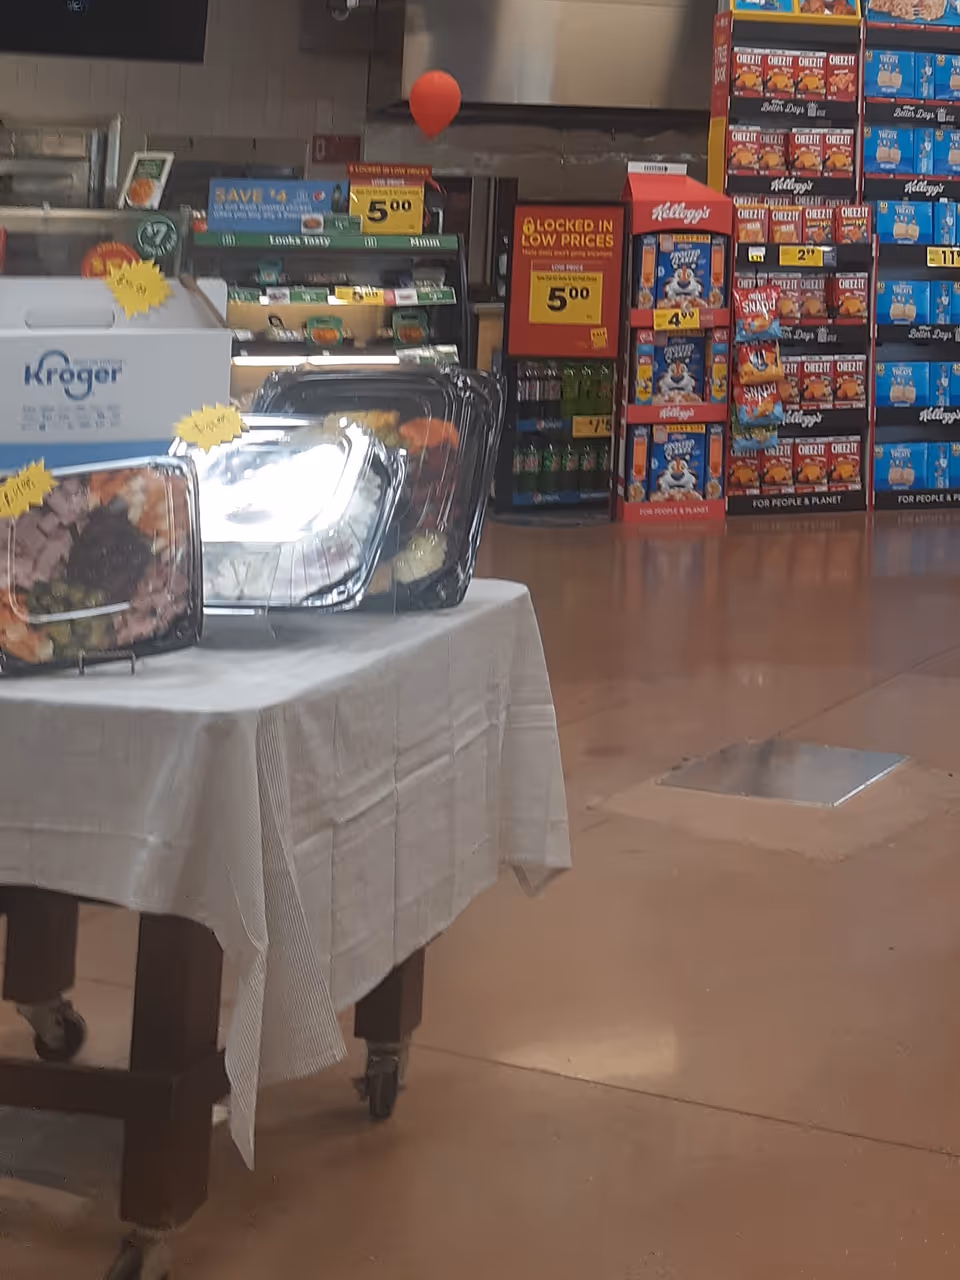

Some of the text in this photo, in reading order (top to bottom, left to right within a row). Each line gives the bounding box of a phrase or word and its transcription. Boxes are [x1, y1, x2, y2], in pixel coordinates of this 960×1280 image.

[770, 177, 813, 194] Kellogg's
[904, 180, 944, 196] Kellogg's
[215, 186, 263, 204] SAVE
[652, 201, 710, 224] Kellogg's
[536, 219, 613, 232] LOCKED IN
[269, 234, 331, 247] Looks Tasty
[522, 234, 614, 247] LOW PRICES
[551, 263, 566, 271] LOW
[24, 350, 123, 400] Kroger
[753, 495, 841, 508] FOR PEOPLE & PLANET
[898, 495, 914, 504] FOR
[916, 494, 944, 503] PEOPLE
